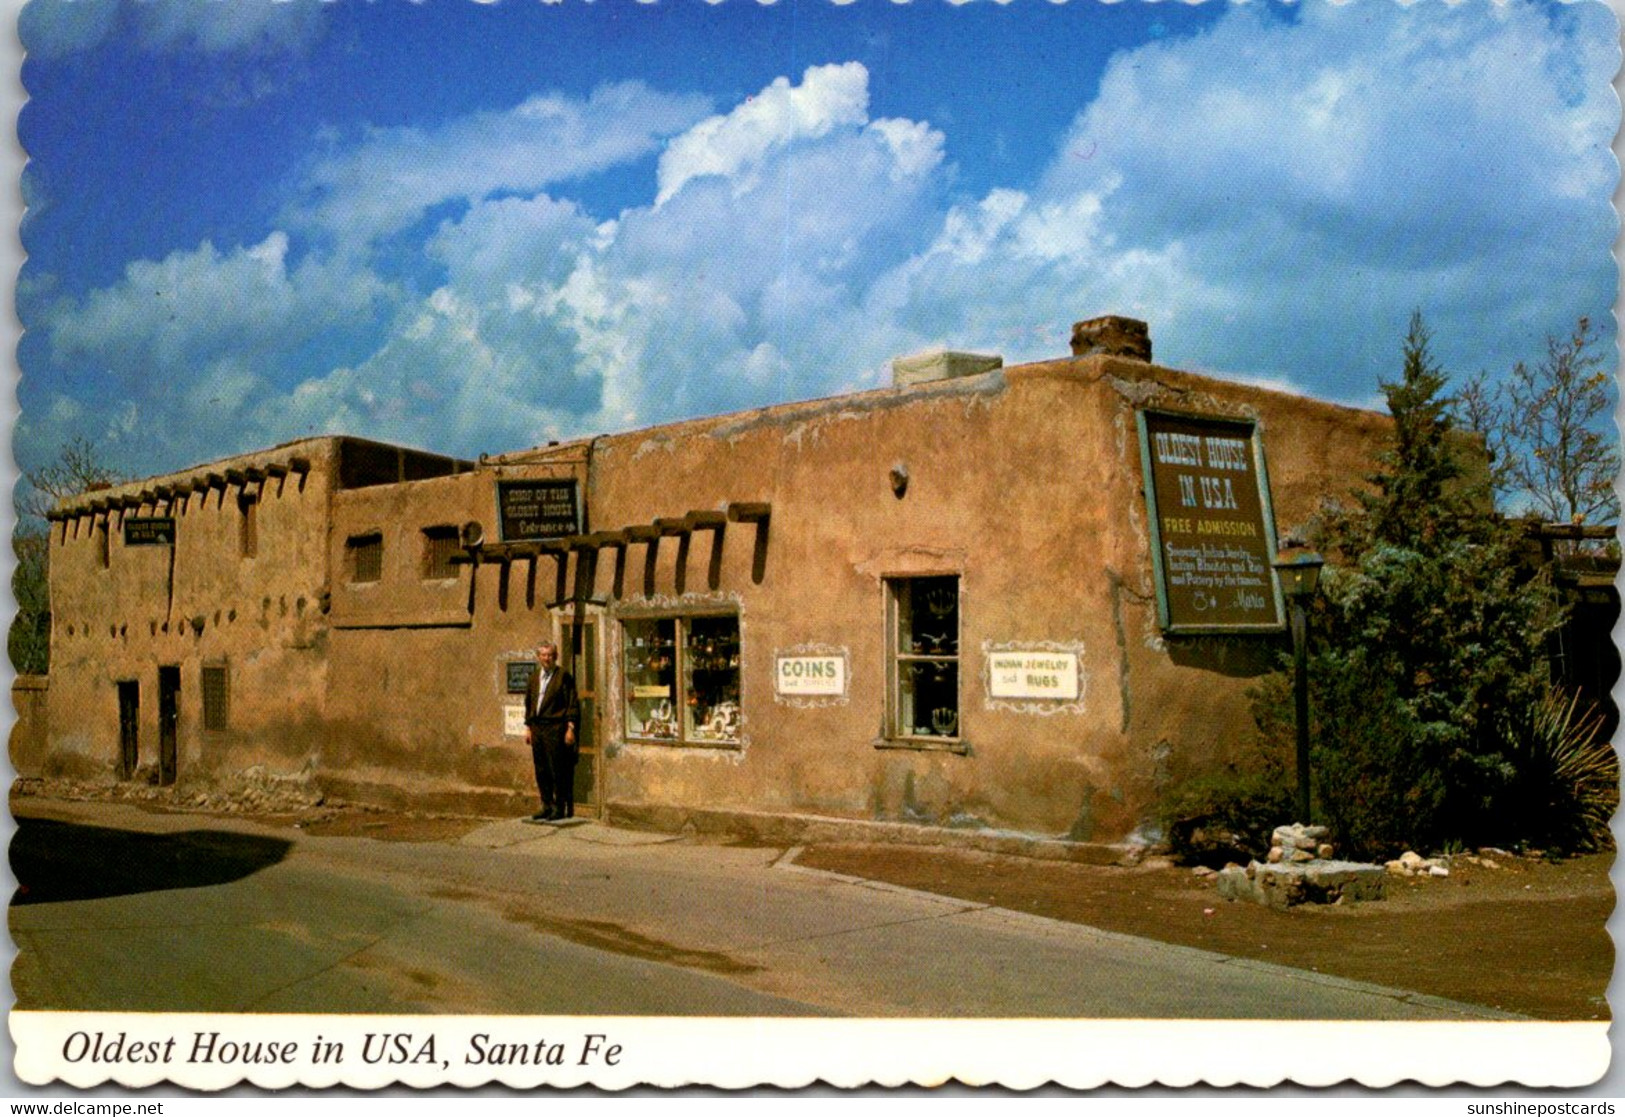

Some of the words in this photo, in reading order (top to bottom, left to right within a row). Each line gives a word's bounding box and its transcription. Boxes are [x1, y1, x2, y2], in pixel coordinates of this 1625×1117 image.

[1156, 433, 1202, 467] OLDEST
[1206, 437, 1247, 471] HOUSE
[1178, 474, 1197, 507] IN
[519, 520, 565, 535] Entrance
[1164, 518, 1192, 534] FREE
[1197, 519, 1256, 537] ADMISSION
[782, 660, 836, 678] COINS
[994, 660, 1023, 669] INDIAN
[1025, 660, 1069, 670] JEWELRY
[1026, 674, 1059, 688] RUGS
